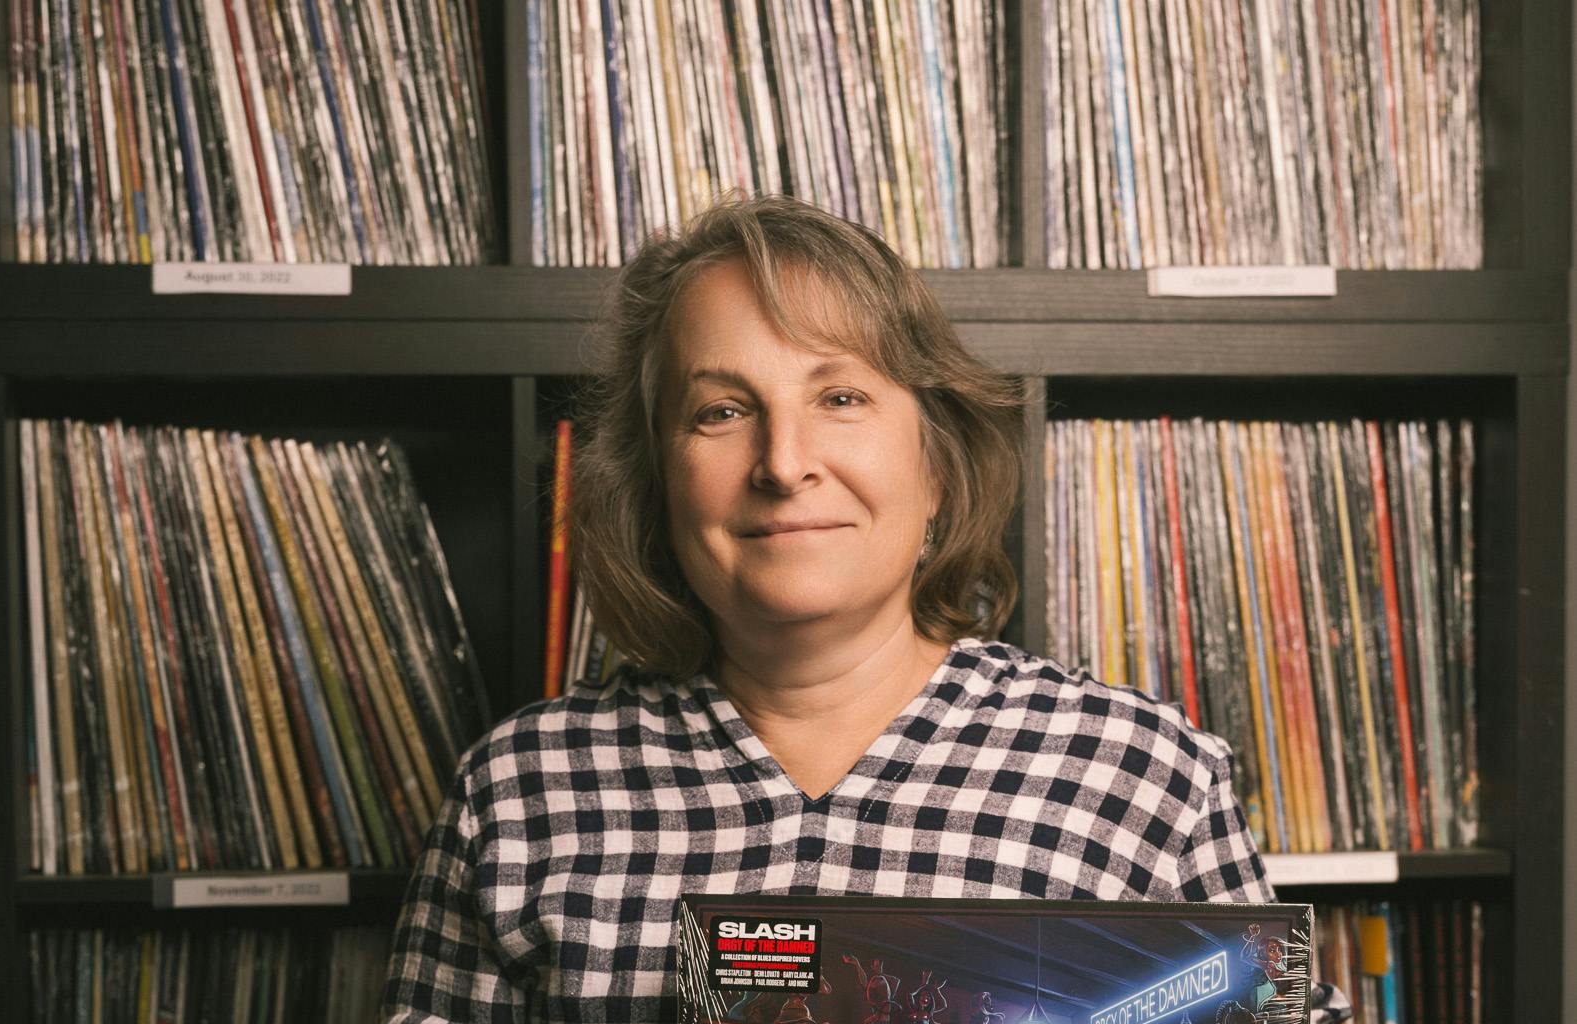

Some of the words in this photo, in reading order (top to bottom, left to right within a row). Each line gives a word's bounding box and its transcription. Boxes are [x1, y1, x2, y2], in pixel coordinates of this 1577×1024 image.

[207, 884, 273, 897] November
[718, 921, 816, 940] SLASH
[718, 938, 742, 951] ORGY
[743, 939, 757, 953] OF
[758, 940, 775, 953] THE
[776, 941, 815, 954] DAMNED
[728, 969, 752, 977] STAPLETON
[765, 970, 780, 978] LOVATO
[755, 978, 765, 986] PAUL
[1133, 991, 1156, 1023] THE
[1158, 959, 1223, 1013] DAMNED
